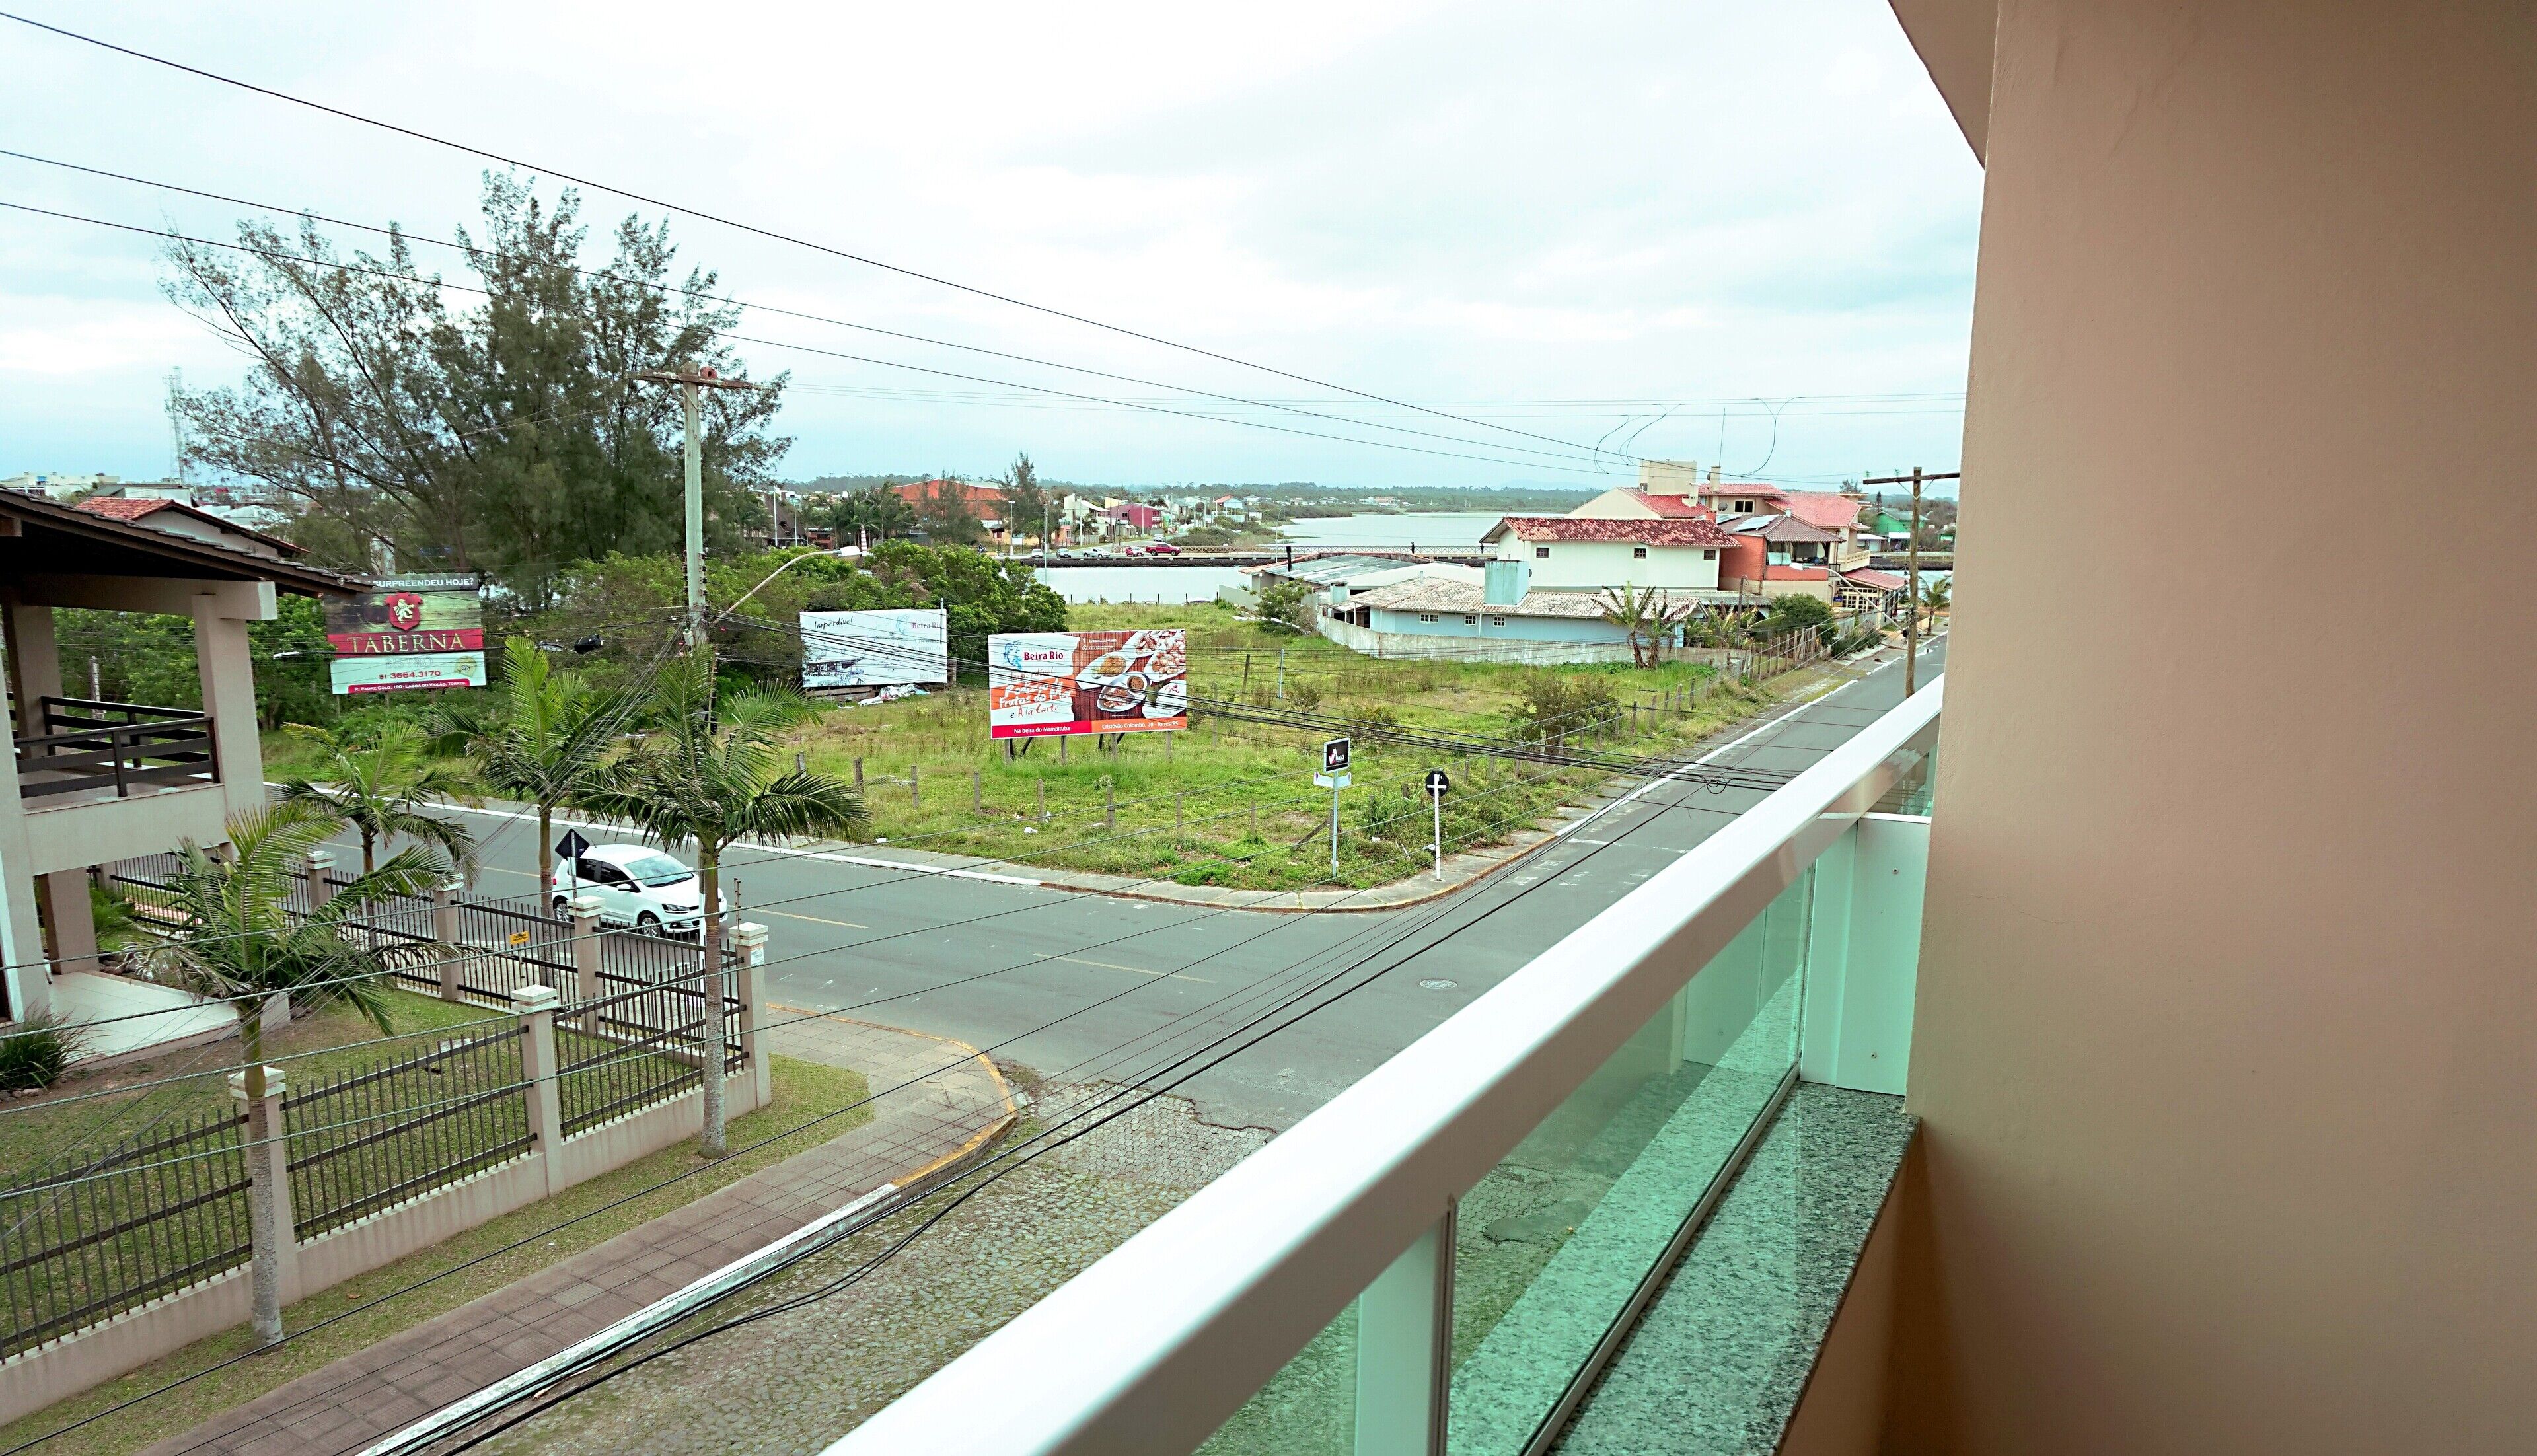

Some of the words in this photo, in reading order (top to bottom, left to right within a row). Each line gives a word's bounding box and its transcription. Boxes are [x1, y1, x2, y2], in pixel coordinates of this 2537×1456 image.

[347, 633, 465, 653] TABERNA
[390, 670, 441, 679] 3664.3170
[1033, 690, 1047, 702] do
[1025, 707, 1033, 715] la
[1036, 704, 1059, 713] Carte
